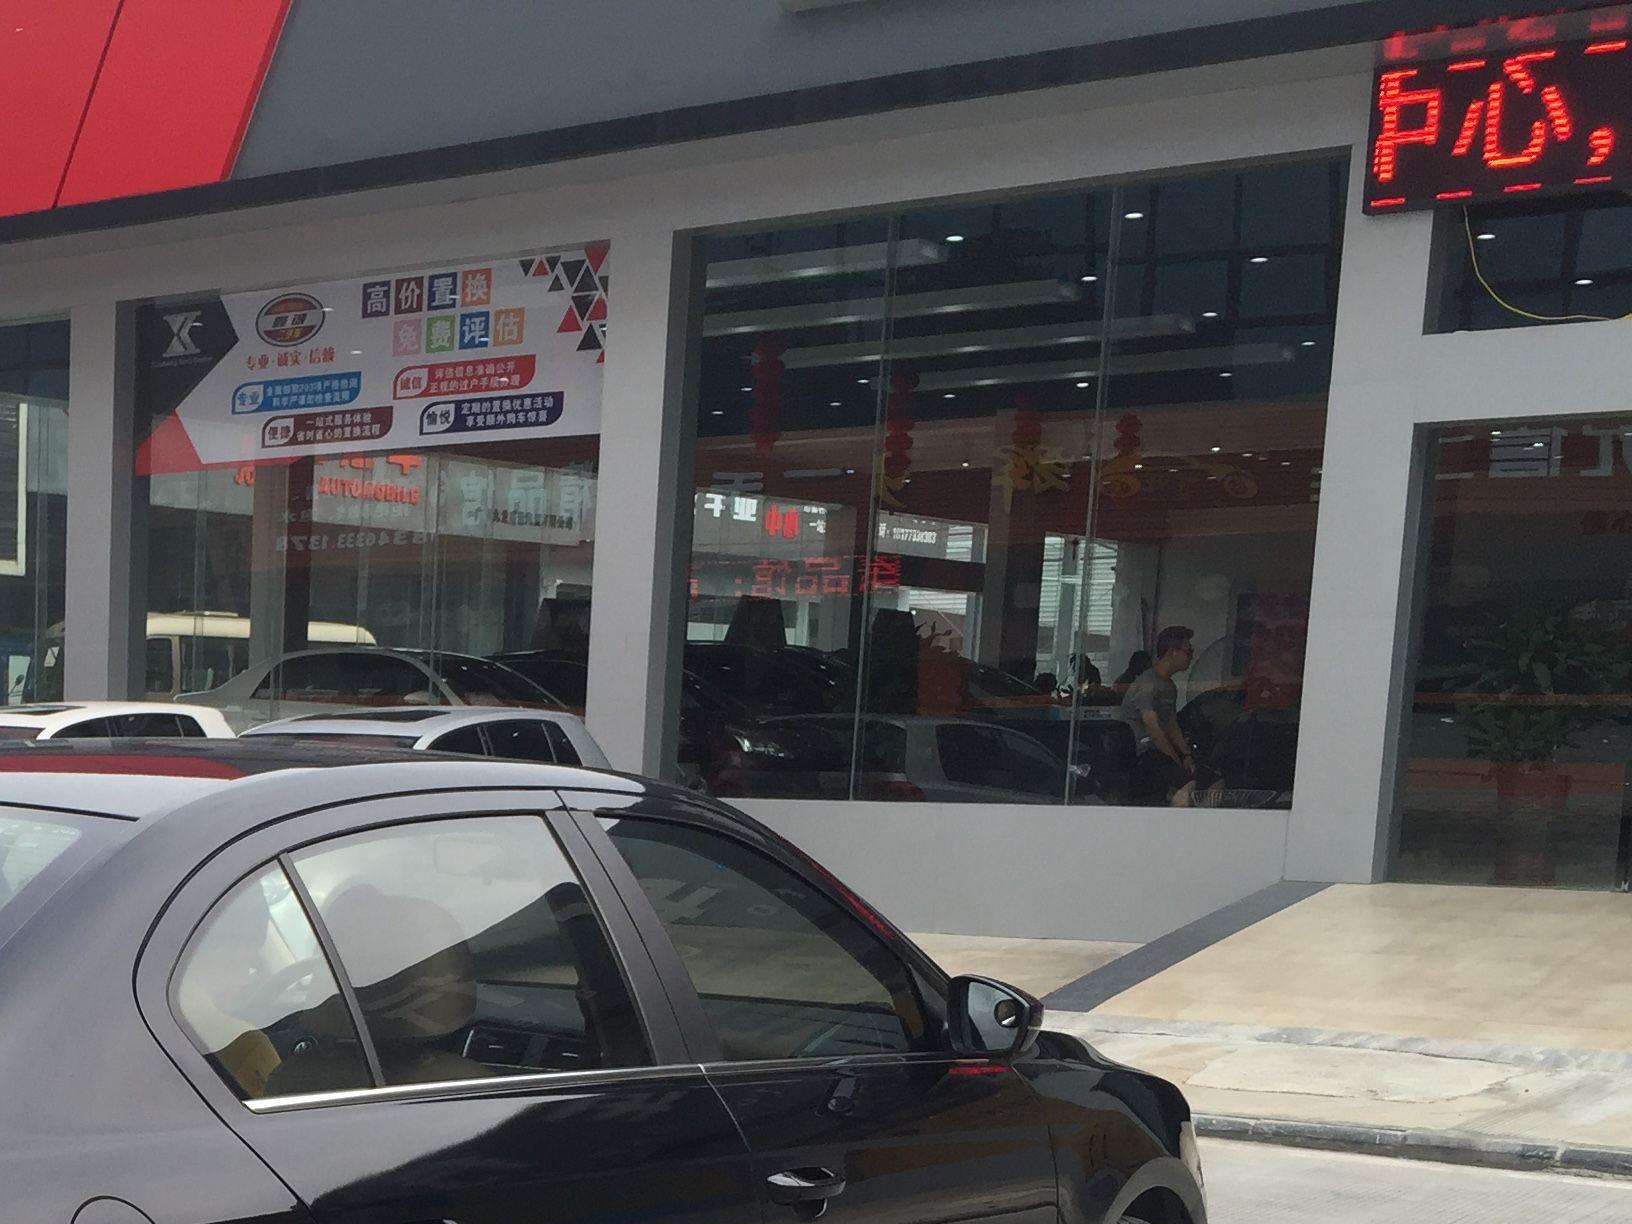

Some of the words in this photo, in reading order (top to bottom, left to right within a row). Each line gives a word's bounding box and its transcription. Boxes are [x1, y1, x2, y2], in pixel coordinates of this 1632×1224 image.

[366, 272, 488, 313] 高价置换
[398, 312, 520, 348] 免费评估
[319, 477, 420, 506] AUTOMOBILE
